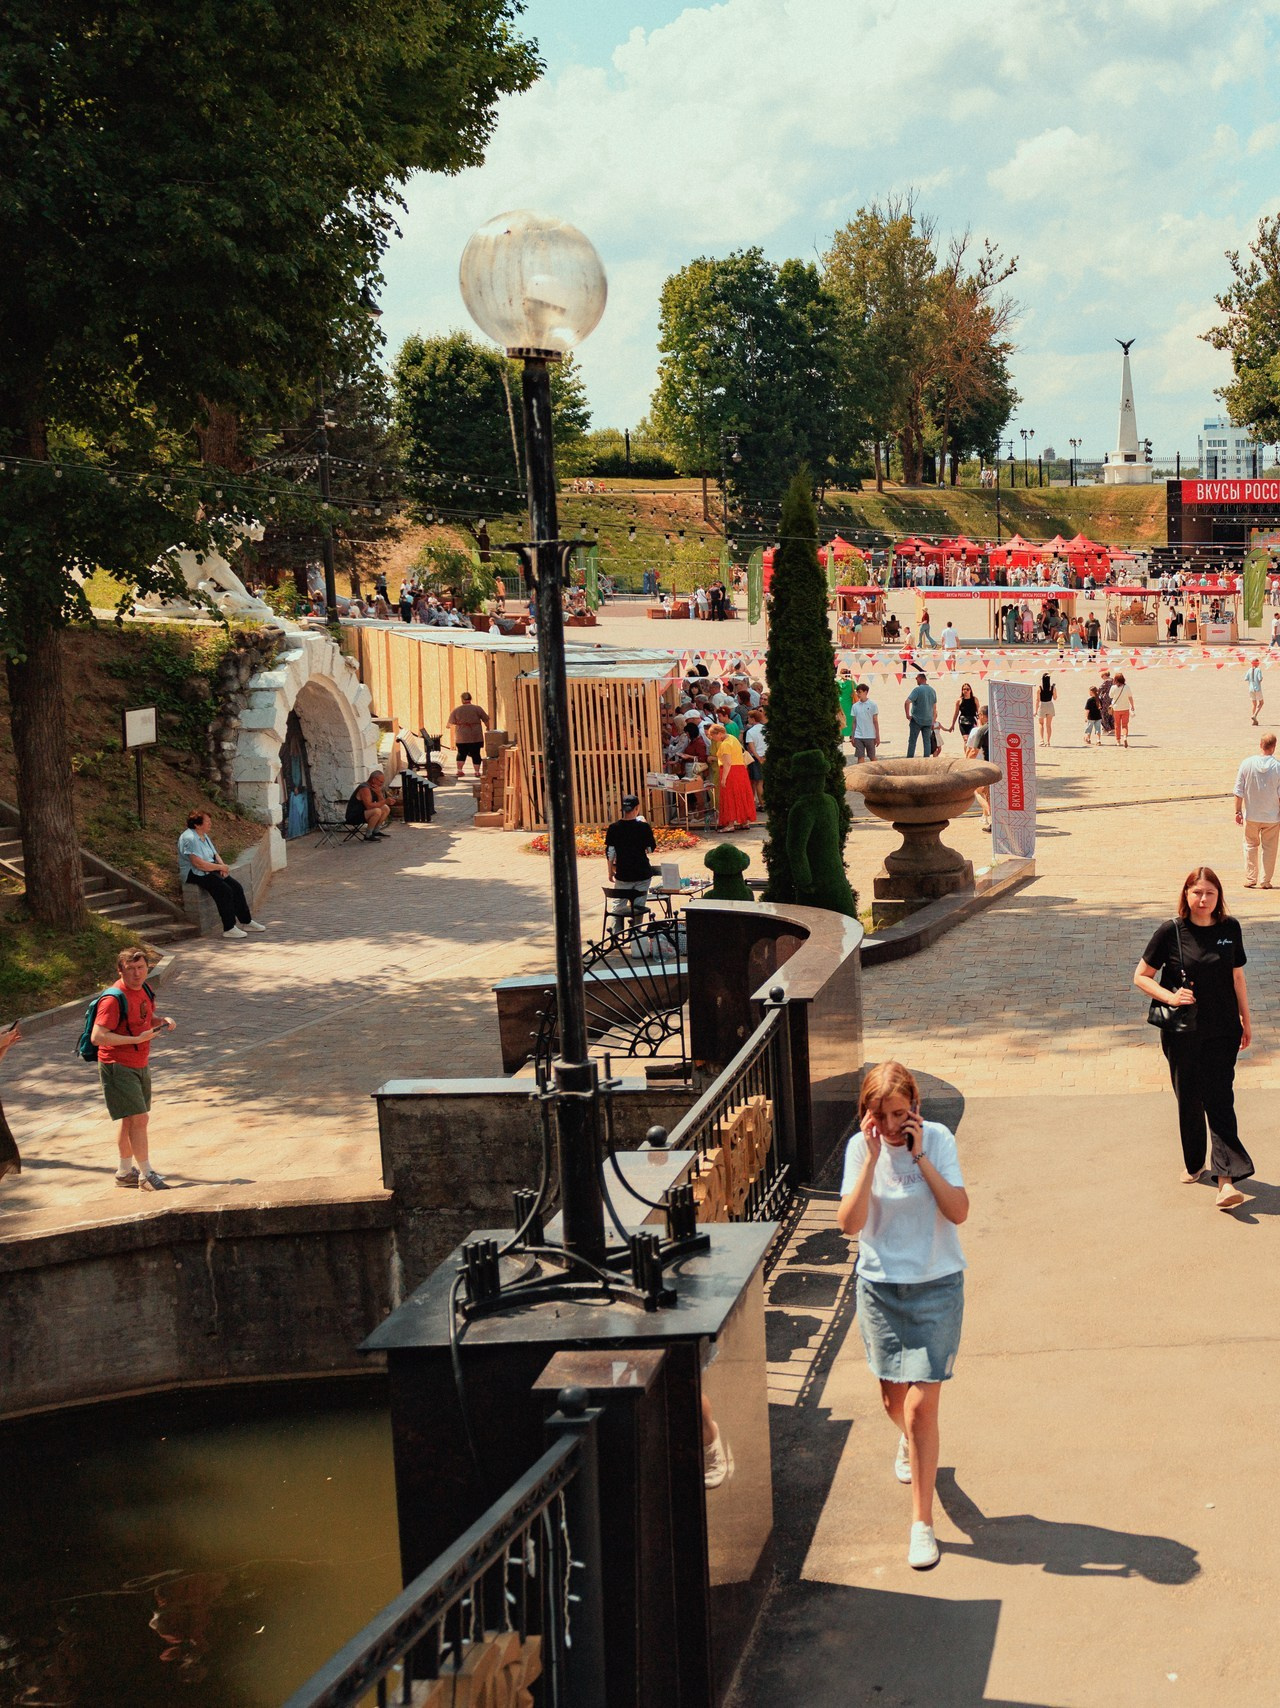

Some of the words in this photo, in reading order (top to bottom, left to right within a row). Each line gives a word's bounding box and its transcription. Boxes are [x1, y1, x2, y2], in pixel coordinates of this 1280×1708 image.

[1196, 482, 1240, 500] ВКУСЫ
[1010, 751, 1020, 781] РОССИИ
[1011, 782, 1021, 808] ВКУСЫ
